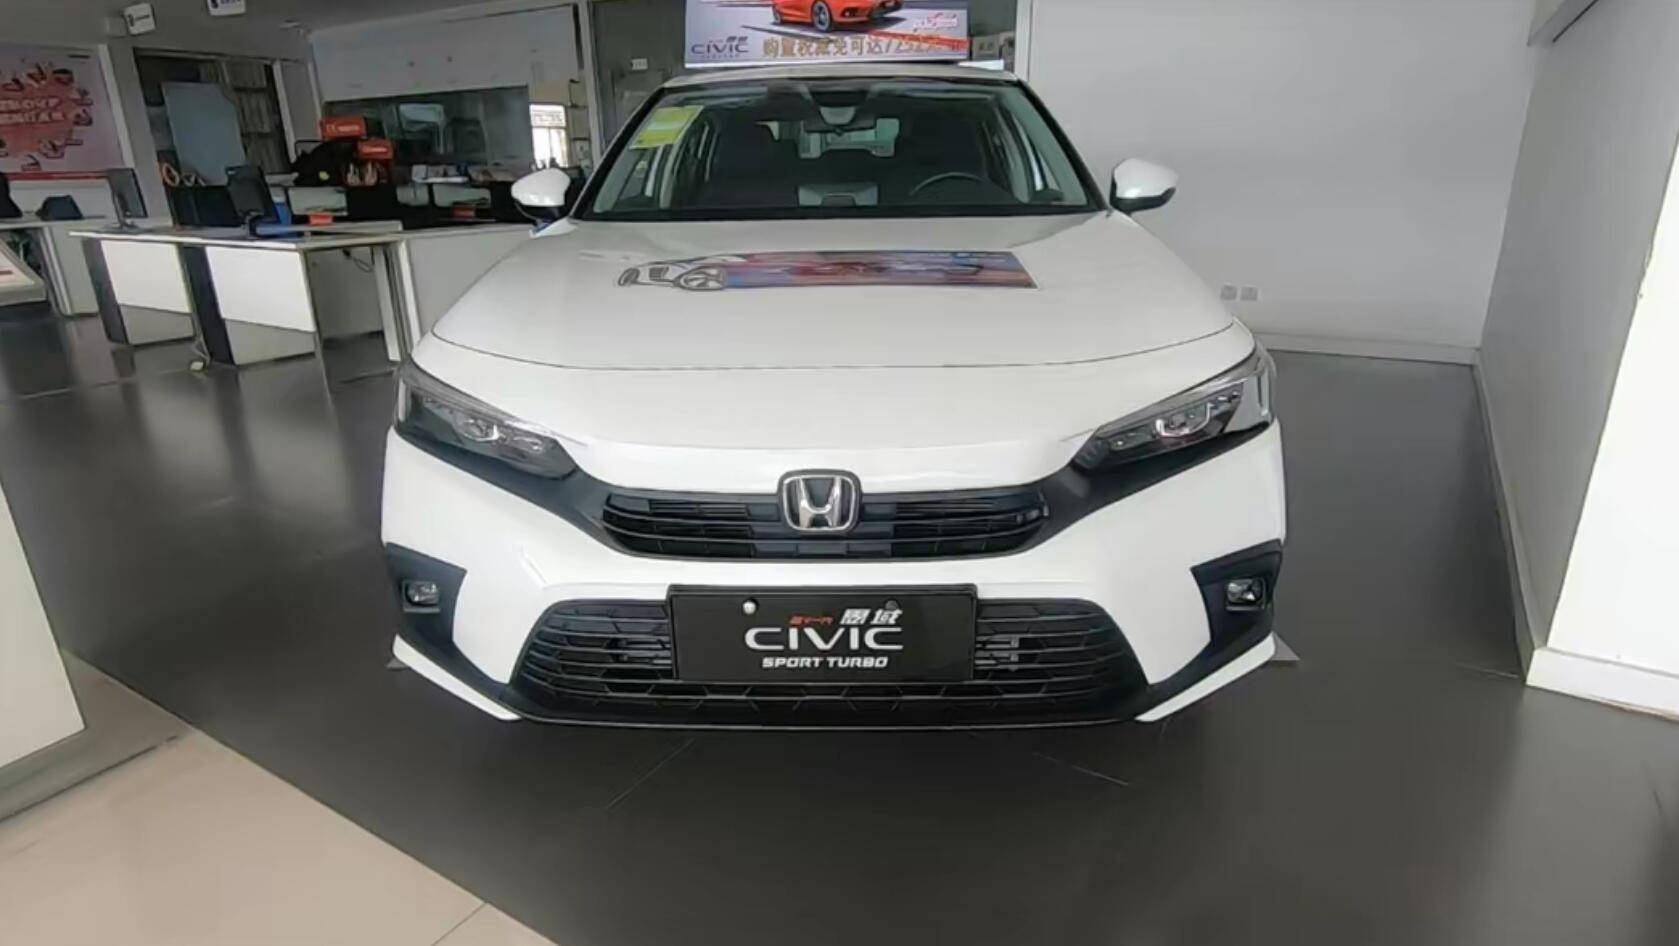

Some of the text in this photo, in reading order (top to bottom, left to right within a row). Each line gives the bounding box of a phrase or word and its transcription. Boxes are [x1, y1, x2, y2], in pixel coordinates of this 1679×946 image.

[691, 43, 749, 54] CIVIC
[744, 627, 904, 650] CIVIC
[762, 656, 889, 668] SPORT TURBO
